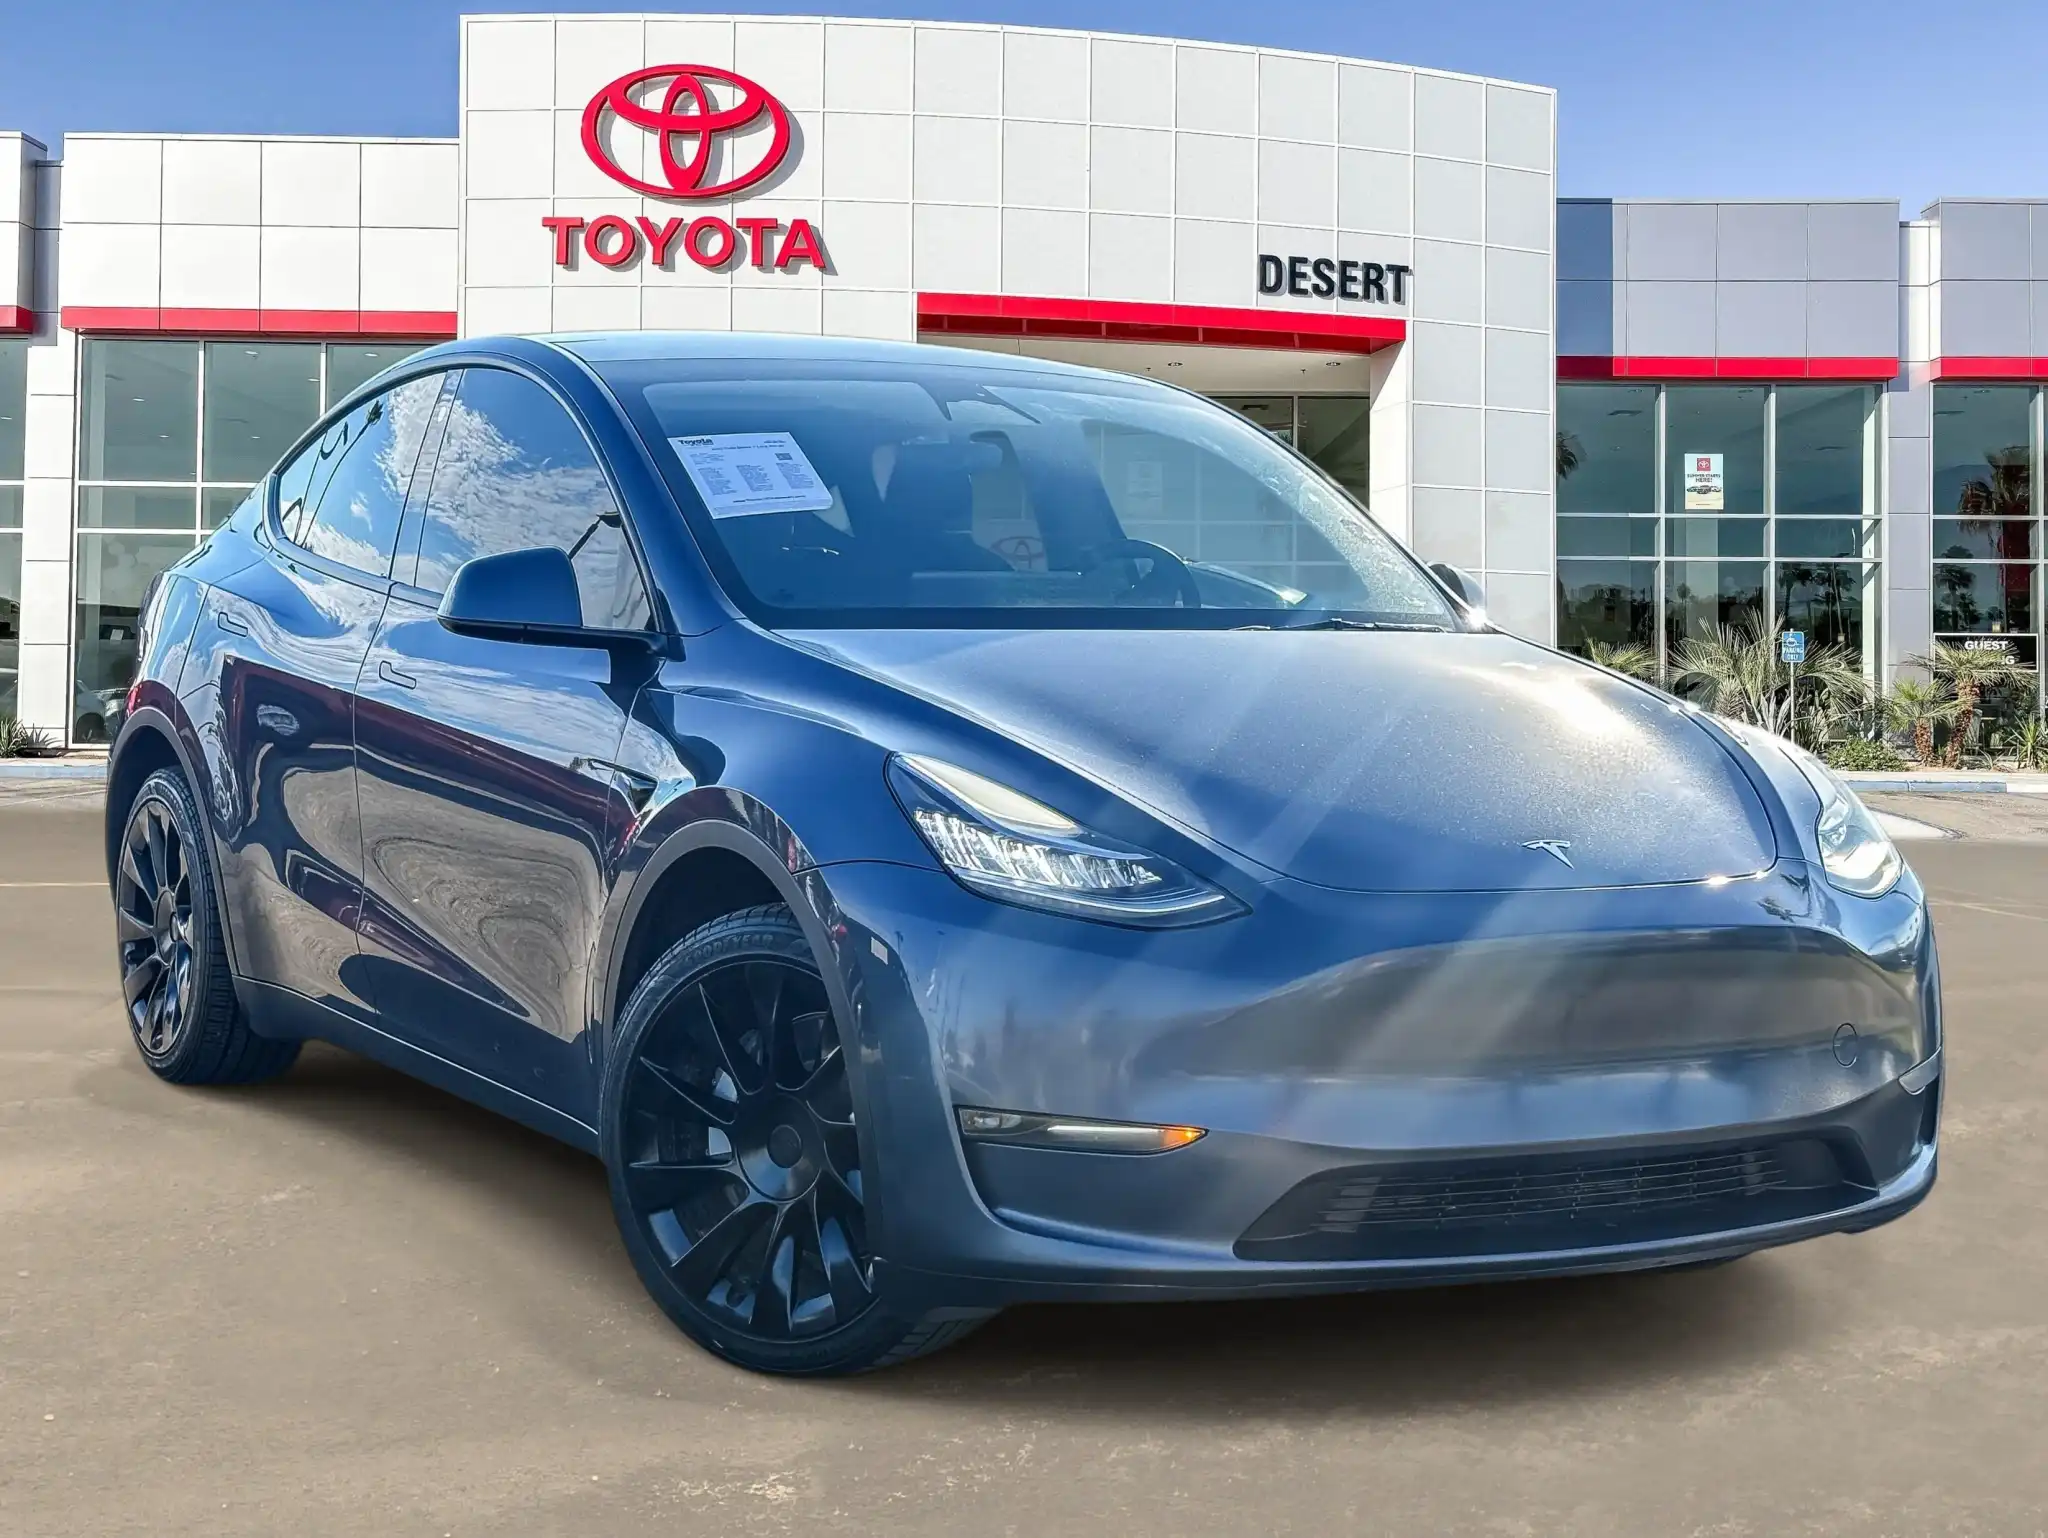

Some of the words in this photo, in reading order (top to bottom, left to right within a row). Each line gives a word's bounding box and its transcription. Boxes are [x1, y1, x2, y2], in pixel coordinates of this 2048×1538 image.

[542, 215, 826, 268] TOYOTA
[1259, 254, 1410, 302] DESERT
[678, 438, 714, 446] Toyota
[1964, 640, 2008, 650] GUEST
